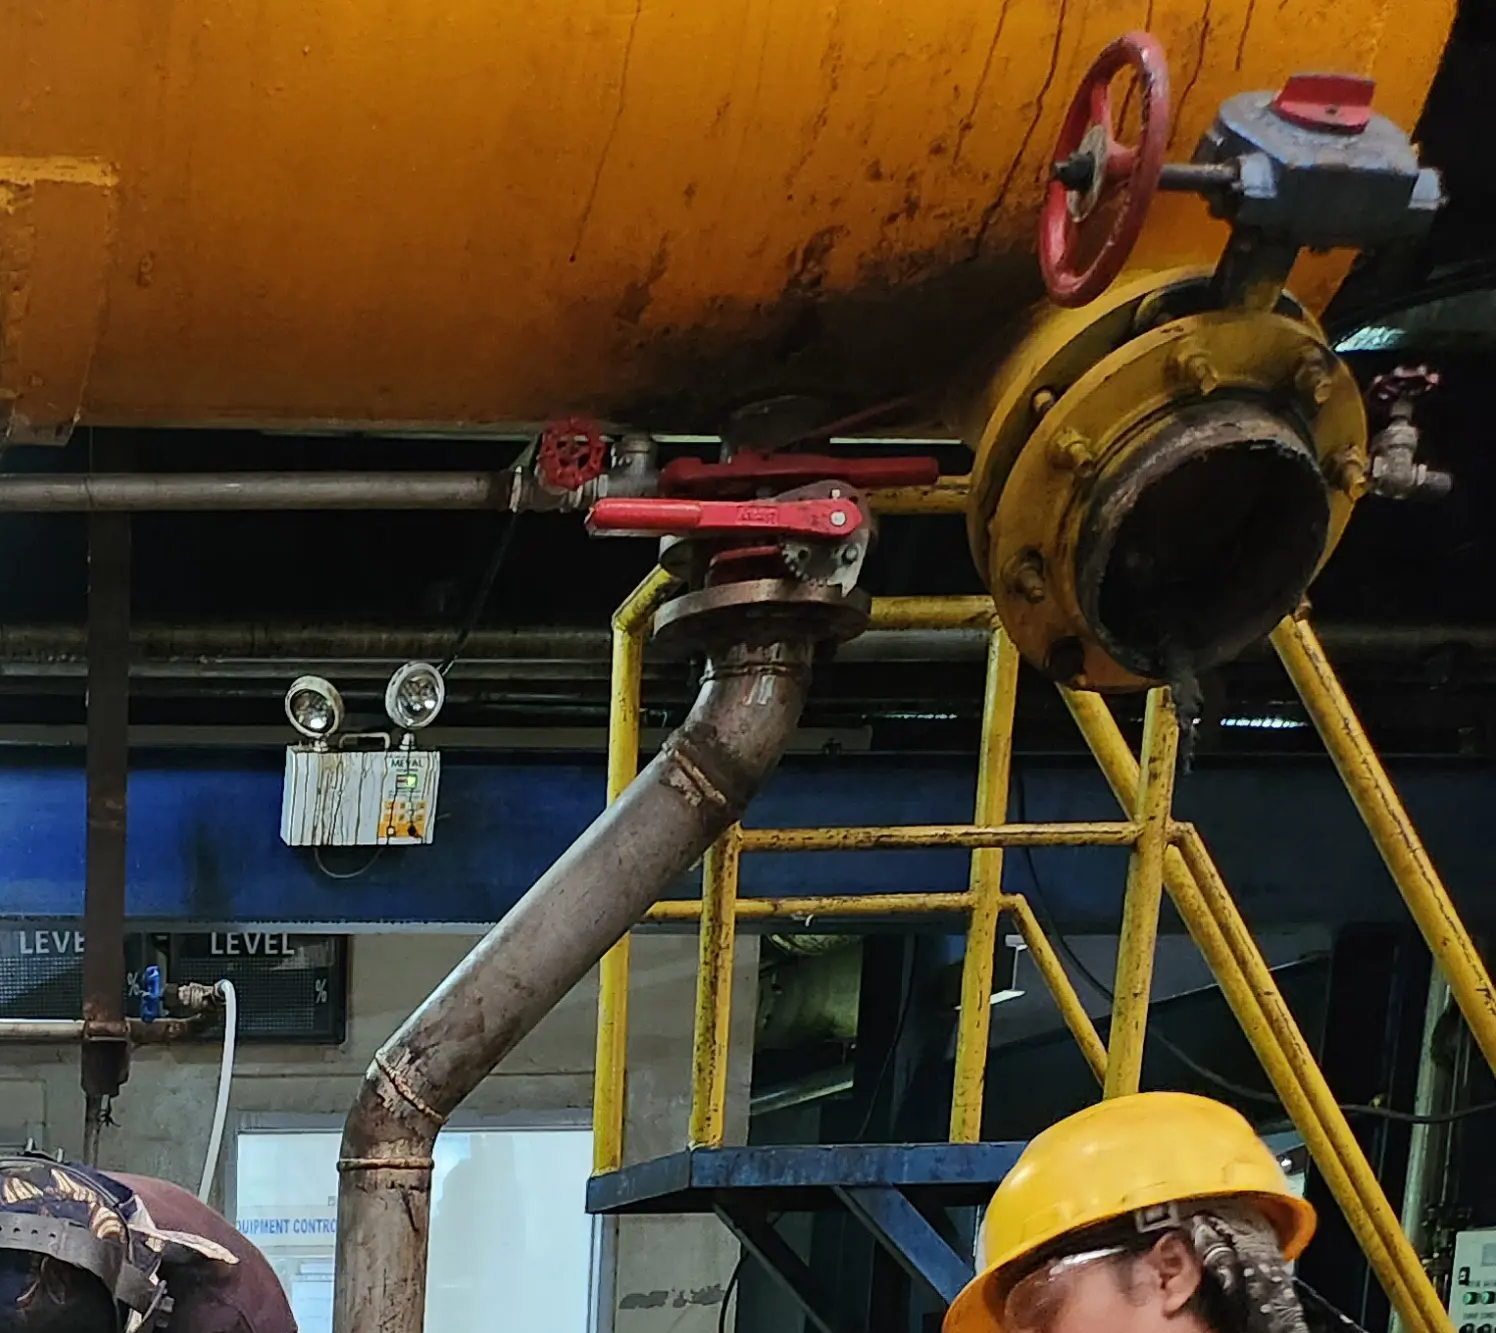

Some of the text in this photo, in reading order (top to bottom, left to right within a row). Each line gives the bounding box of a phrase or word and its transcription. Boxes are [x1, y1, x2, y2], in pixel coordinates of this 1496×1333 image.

[19, 930, 85, 955] LEVE
[210, 931, 295, 955] LEVEL
[315, 978, 328, 1004] %
